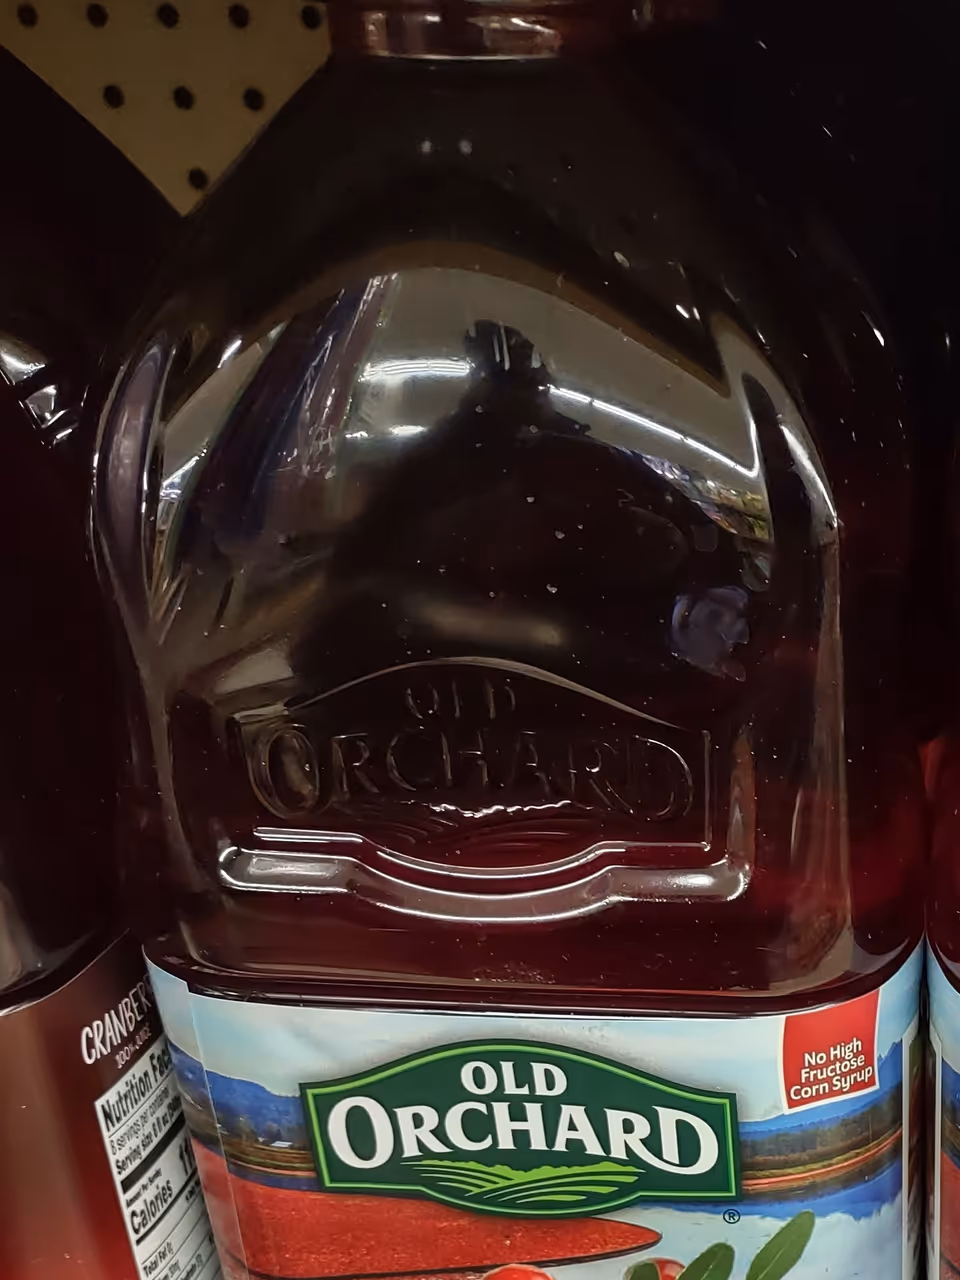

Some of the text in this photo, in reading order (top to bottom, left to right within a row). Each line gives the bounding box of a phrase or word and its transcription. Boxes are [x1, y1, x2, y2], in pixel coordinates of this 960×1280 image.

[81, 976, 153, 1064] CRANBER
[801, 1054, 865, 1083] Fructose
[804, 1037, 862, 1067] No High
[460, 1060, 568, 1096] OLD
[790, 1066, 873, 1100] Corn Syrup
[100, 1073, 153, 1132] Nutrition
[327, 1096, 720, 1175] ORCHARD
[115, 1143, 143, 1175] Serving
[130, 1179, 174, 1235] Calories
